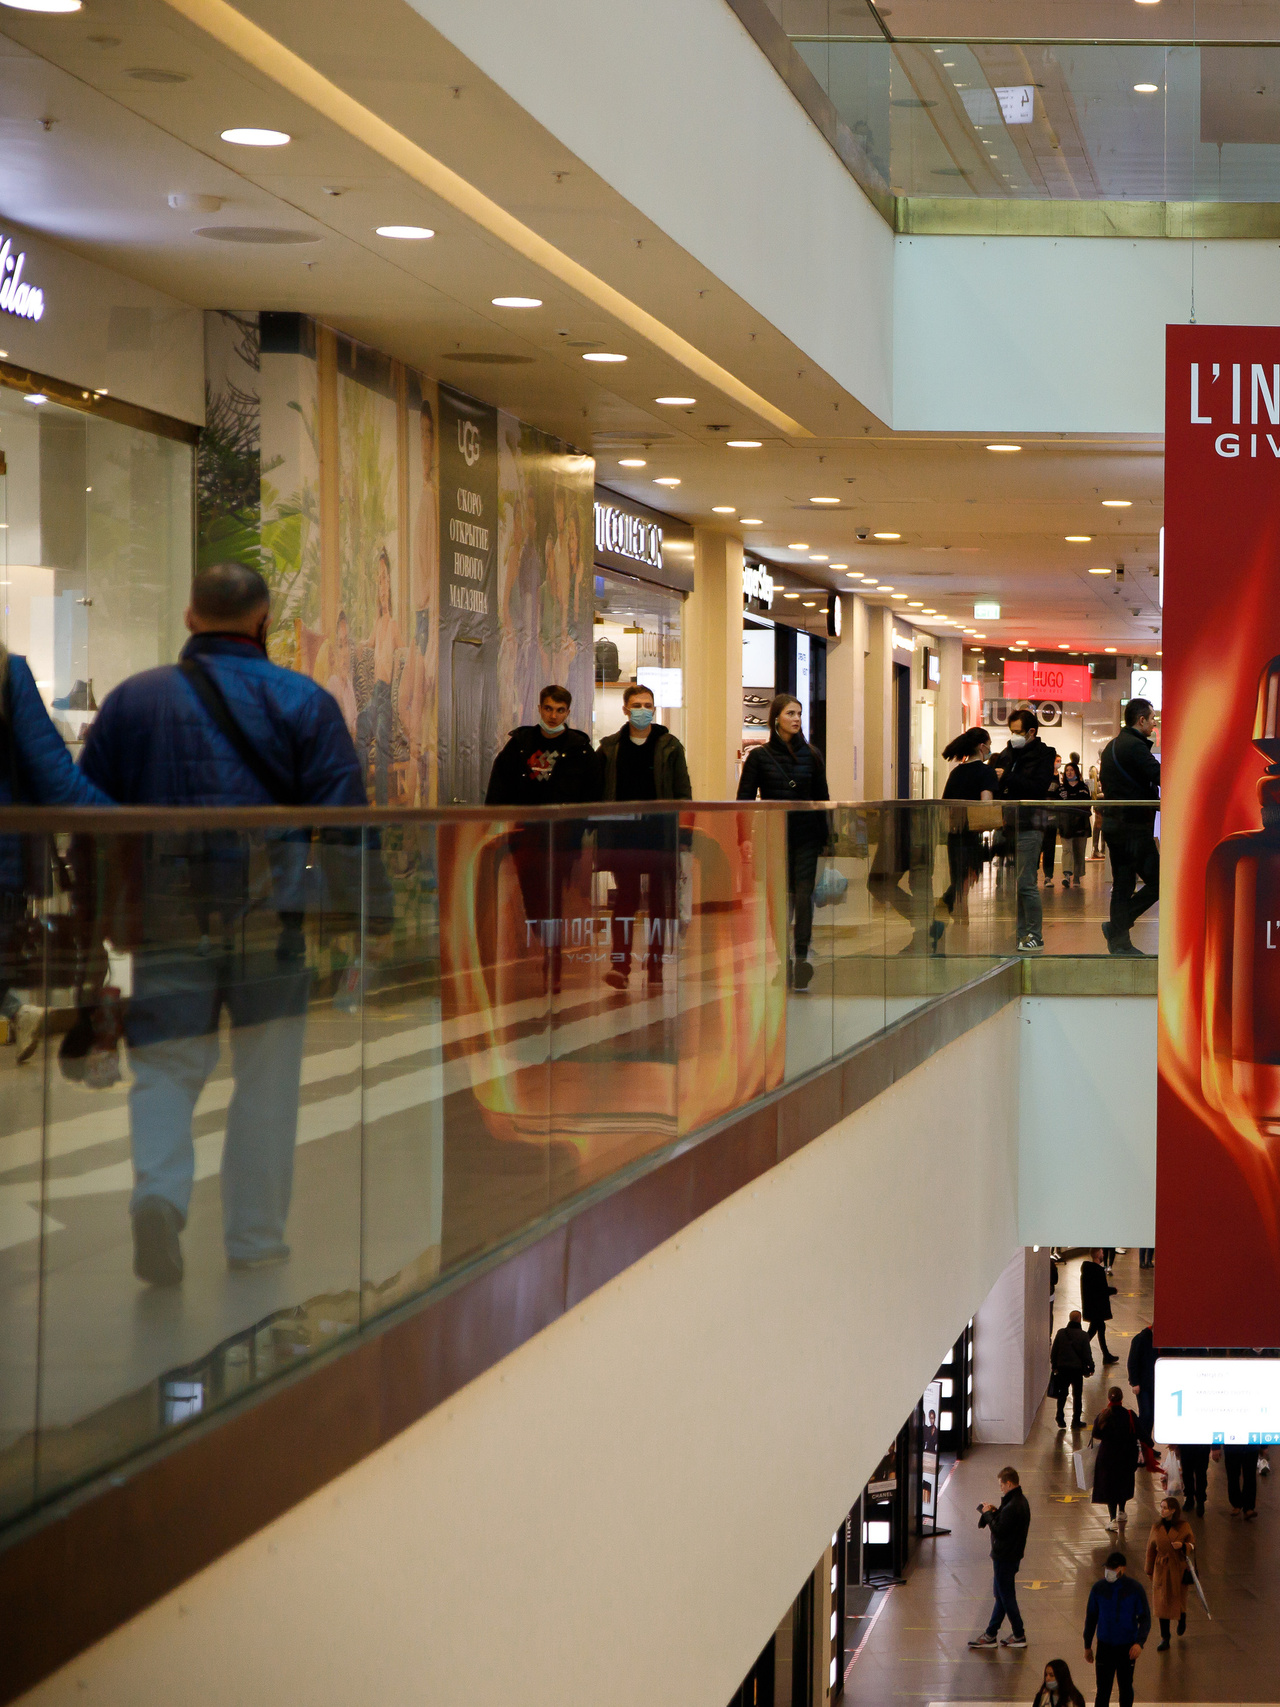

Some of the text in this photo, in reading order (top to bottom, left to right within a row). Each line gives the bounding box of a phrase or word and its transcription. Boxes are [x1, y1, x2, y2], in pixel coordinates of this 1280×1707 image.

[457, 418, 480, 467] UGG
[456, 487, 483, 517] СКОРО
[449, 517, 489, 551] ОТКРЫТИЕ
[453, 552, 483, 581] НОВОГО
[449, 584, 488, 615] МАГАЗИНА
[1032, 670, 1064, 688] HUGO
[1137, 676, 1148, 697] 2
[1170, 1389, 1183, 1417] 1
[871, 1491, 893, 1499] CHANEL
